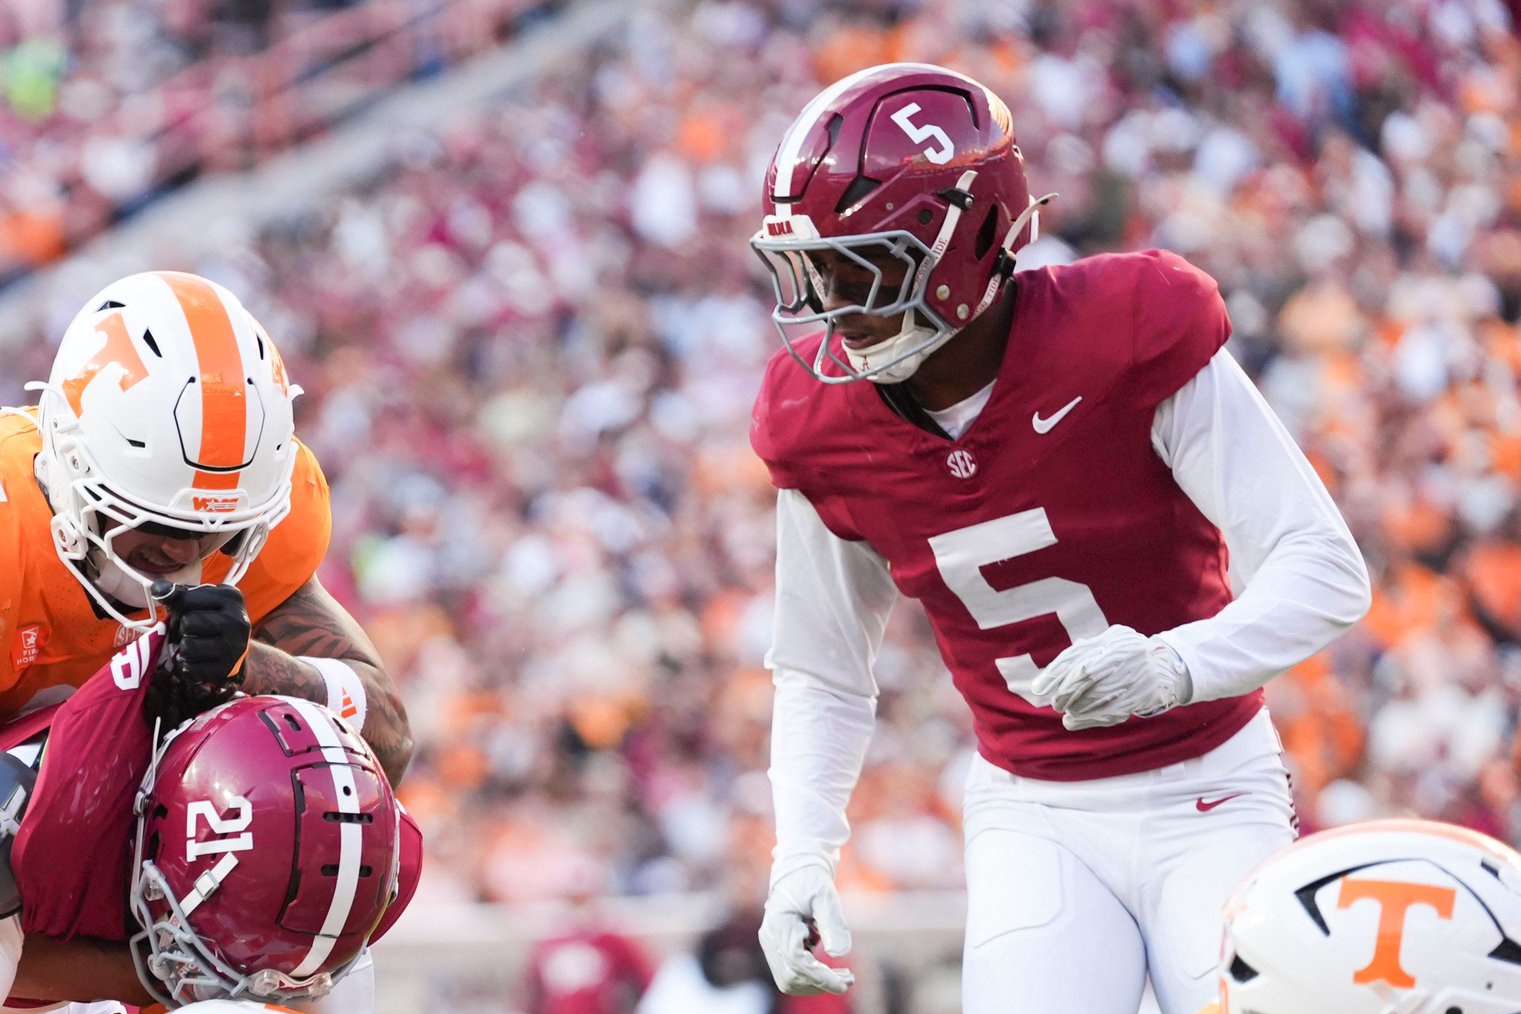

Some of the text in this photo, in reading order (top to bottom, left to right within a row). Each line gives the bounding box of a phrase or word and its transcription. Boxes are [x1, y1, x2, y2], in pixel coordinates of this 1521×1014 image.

[890, 102, 955, 165] 5
[62, 313, 149, 419] T
[946, 449, 976, 479] SEC
[928, 507, 1110, 708] 5
[186, 795, 254, 863] 21
[1337, 876, 1457, 989] T
